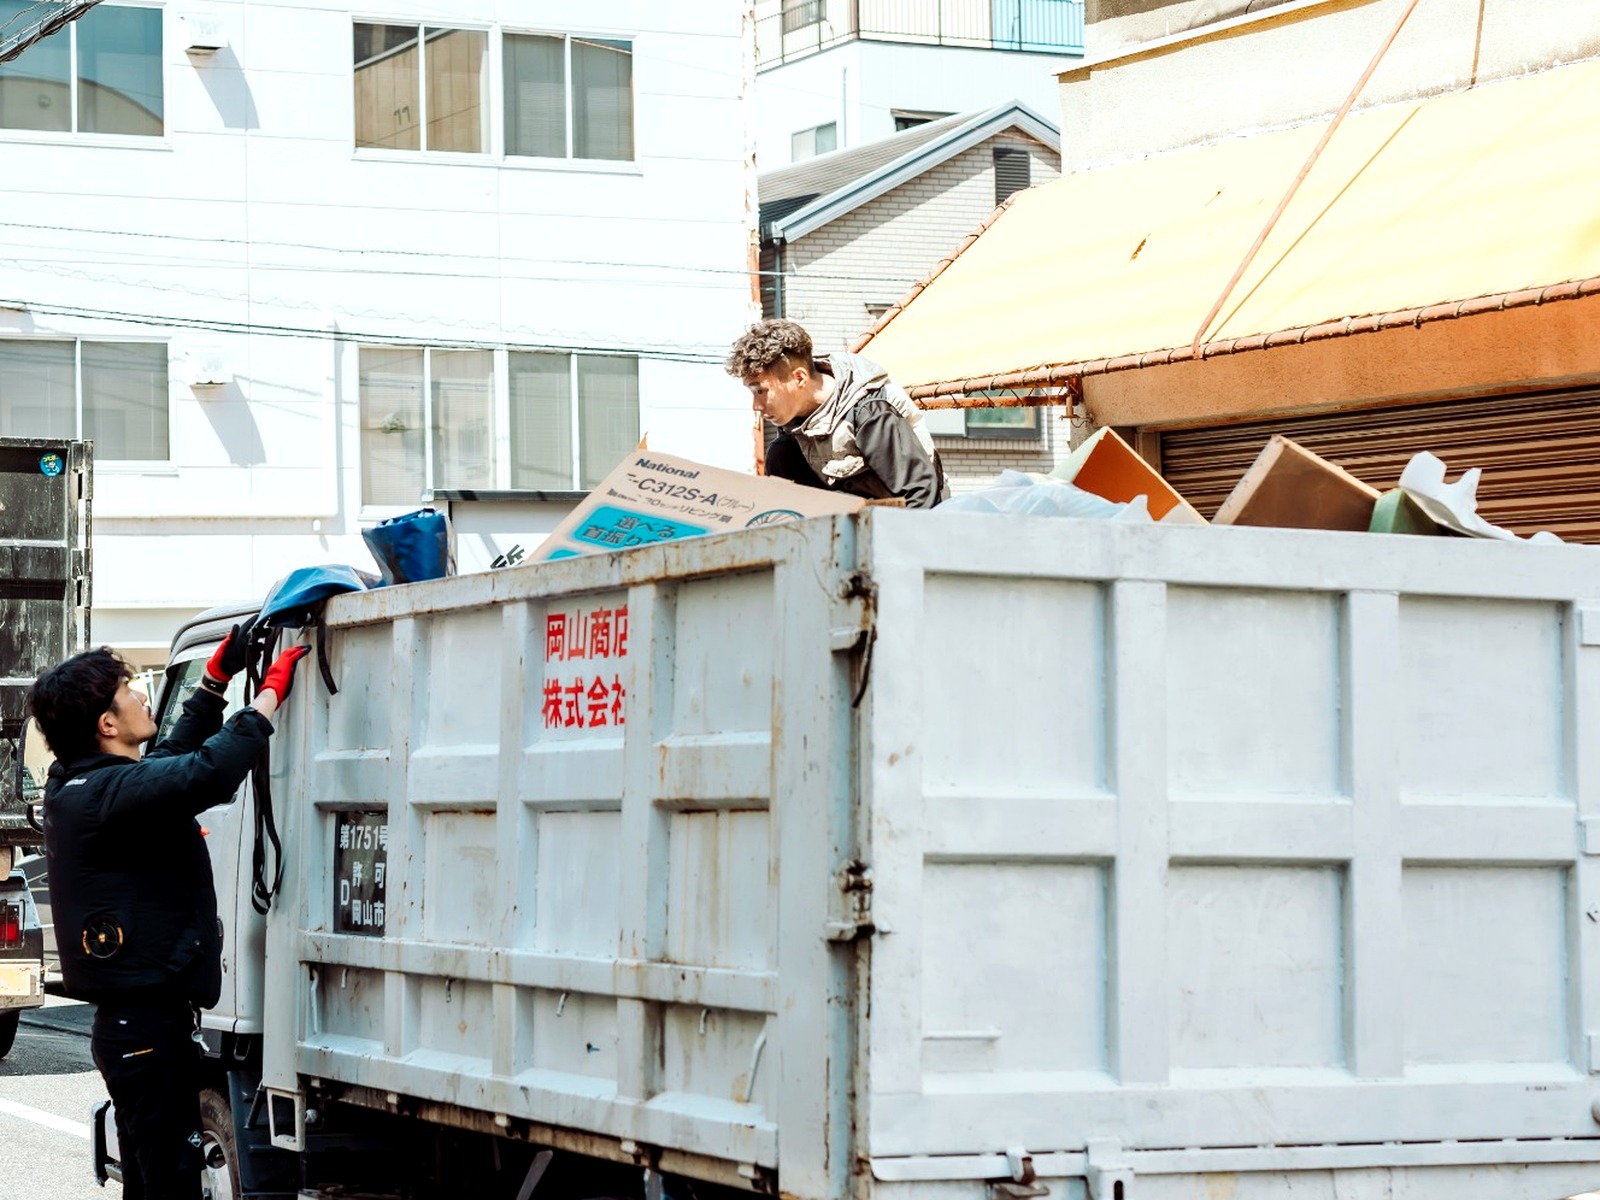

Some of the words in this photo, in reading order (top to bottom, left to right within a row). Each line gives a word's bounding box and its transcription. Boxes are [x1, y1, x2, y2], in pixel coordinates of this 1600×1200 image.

[635, 458, 700, 480] National
[541, 673, 626, 729] 株式会社
[339, 824, 388, 851] 第1751号
